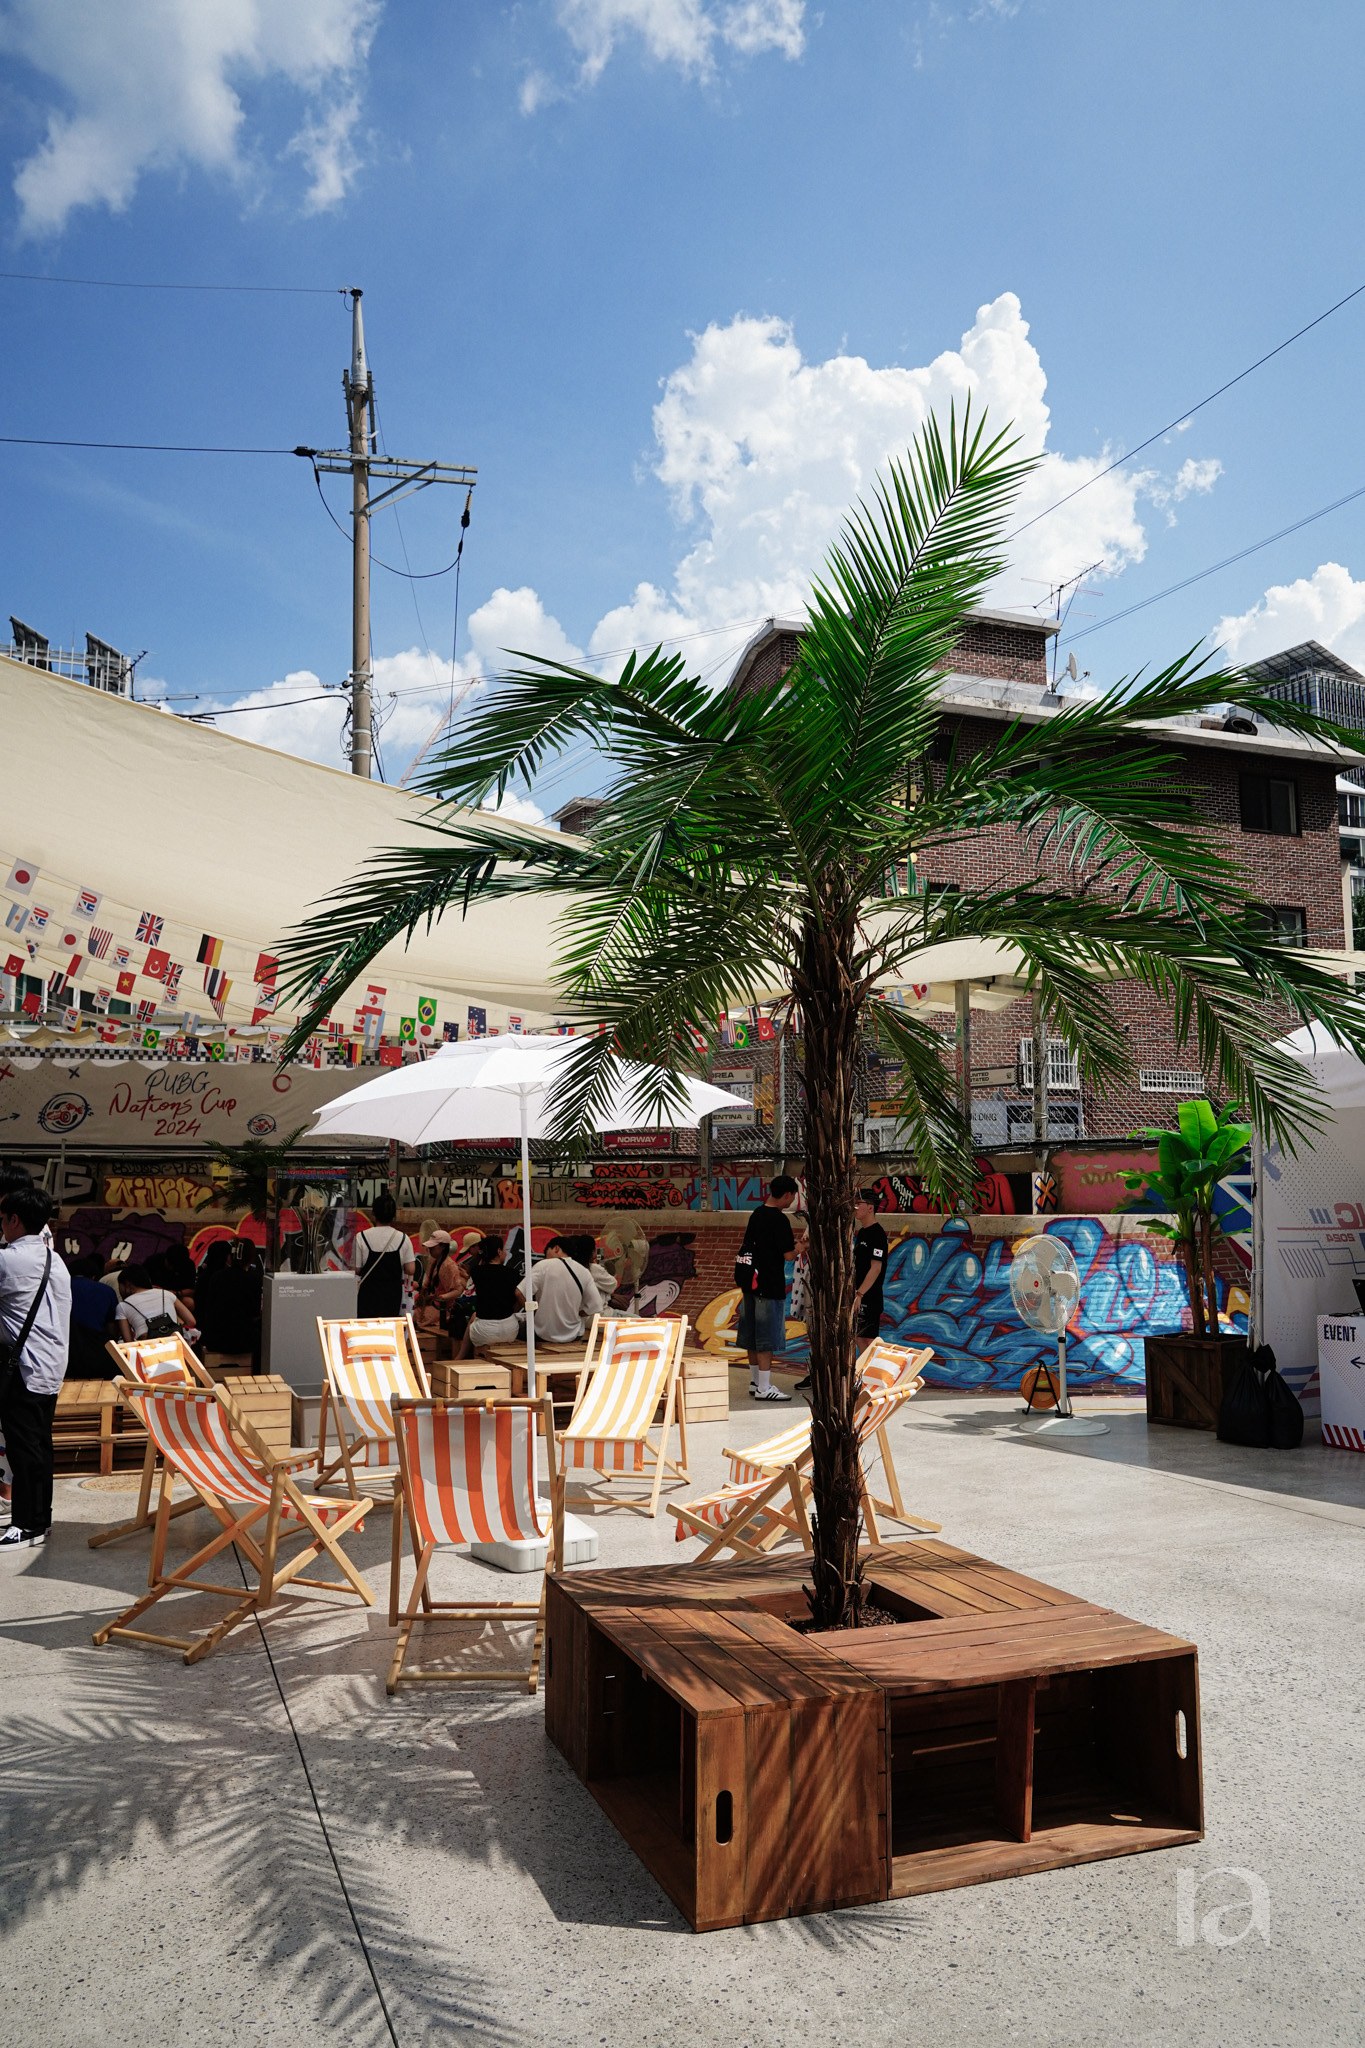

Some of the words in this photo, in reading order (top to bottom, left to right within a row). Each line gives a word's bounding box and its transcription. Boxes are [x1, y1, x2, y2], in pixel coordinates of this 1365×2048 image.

[878, 1057, 906, 1065] THAIL
[145, 1068, 210, 1098] PUBG
[109, 1082, 193, 1121] Nations
[200, 1087, 237, 1117] Cup
[154, 1118, 201, 1137] 2024
[617, 1135, 657, 1144] NORWAY
[1323, 1324, 1357, 1342] EVENT
